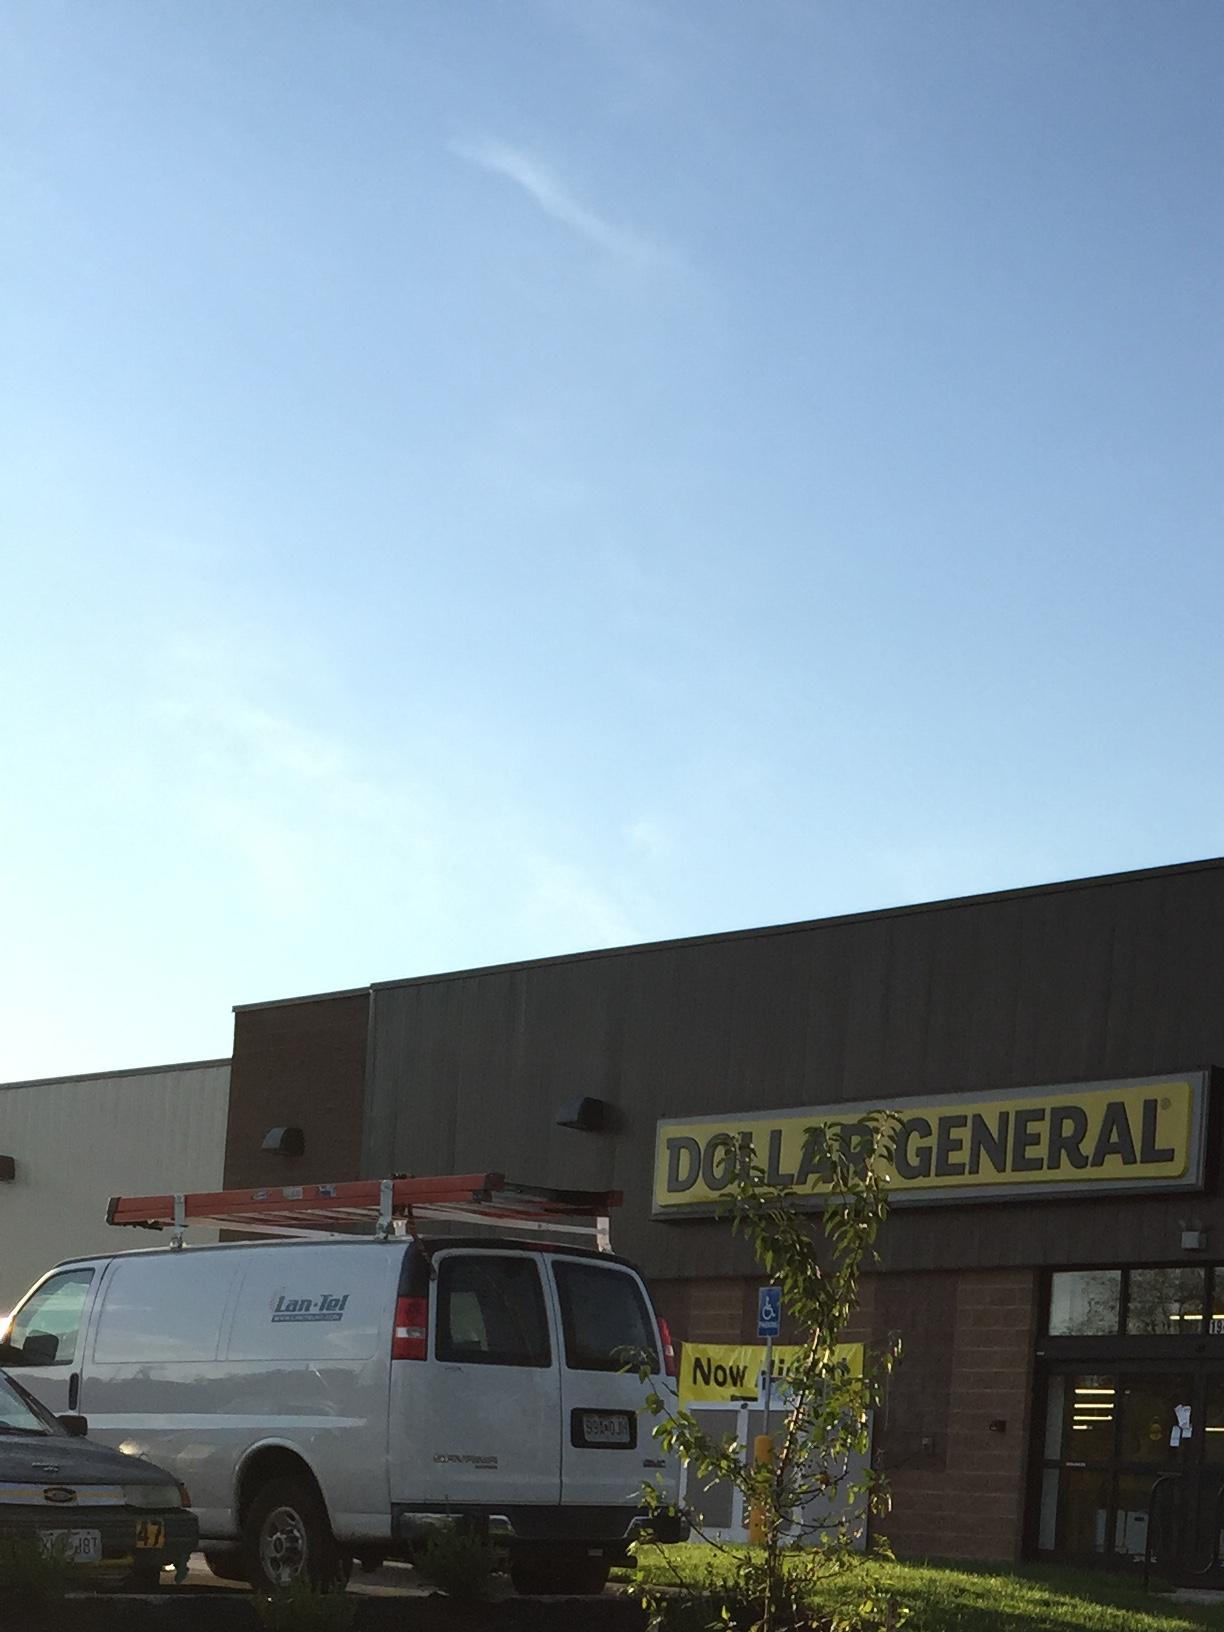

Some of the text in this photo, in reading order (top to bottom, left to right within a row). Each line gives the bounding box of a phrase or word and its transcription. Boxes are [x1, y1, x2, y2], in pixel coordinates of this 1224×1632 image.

[666, 1099, 1175, 1193] DOLLAR GENERAL
[692, 1356, 749, 1388] Now
[136, 1520, 164, 1547] 47
